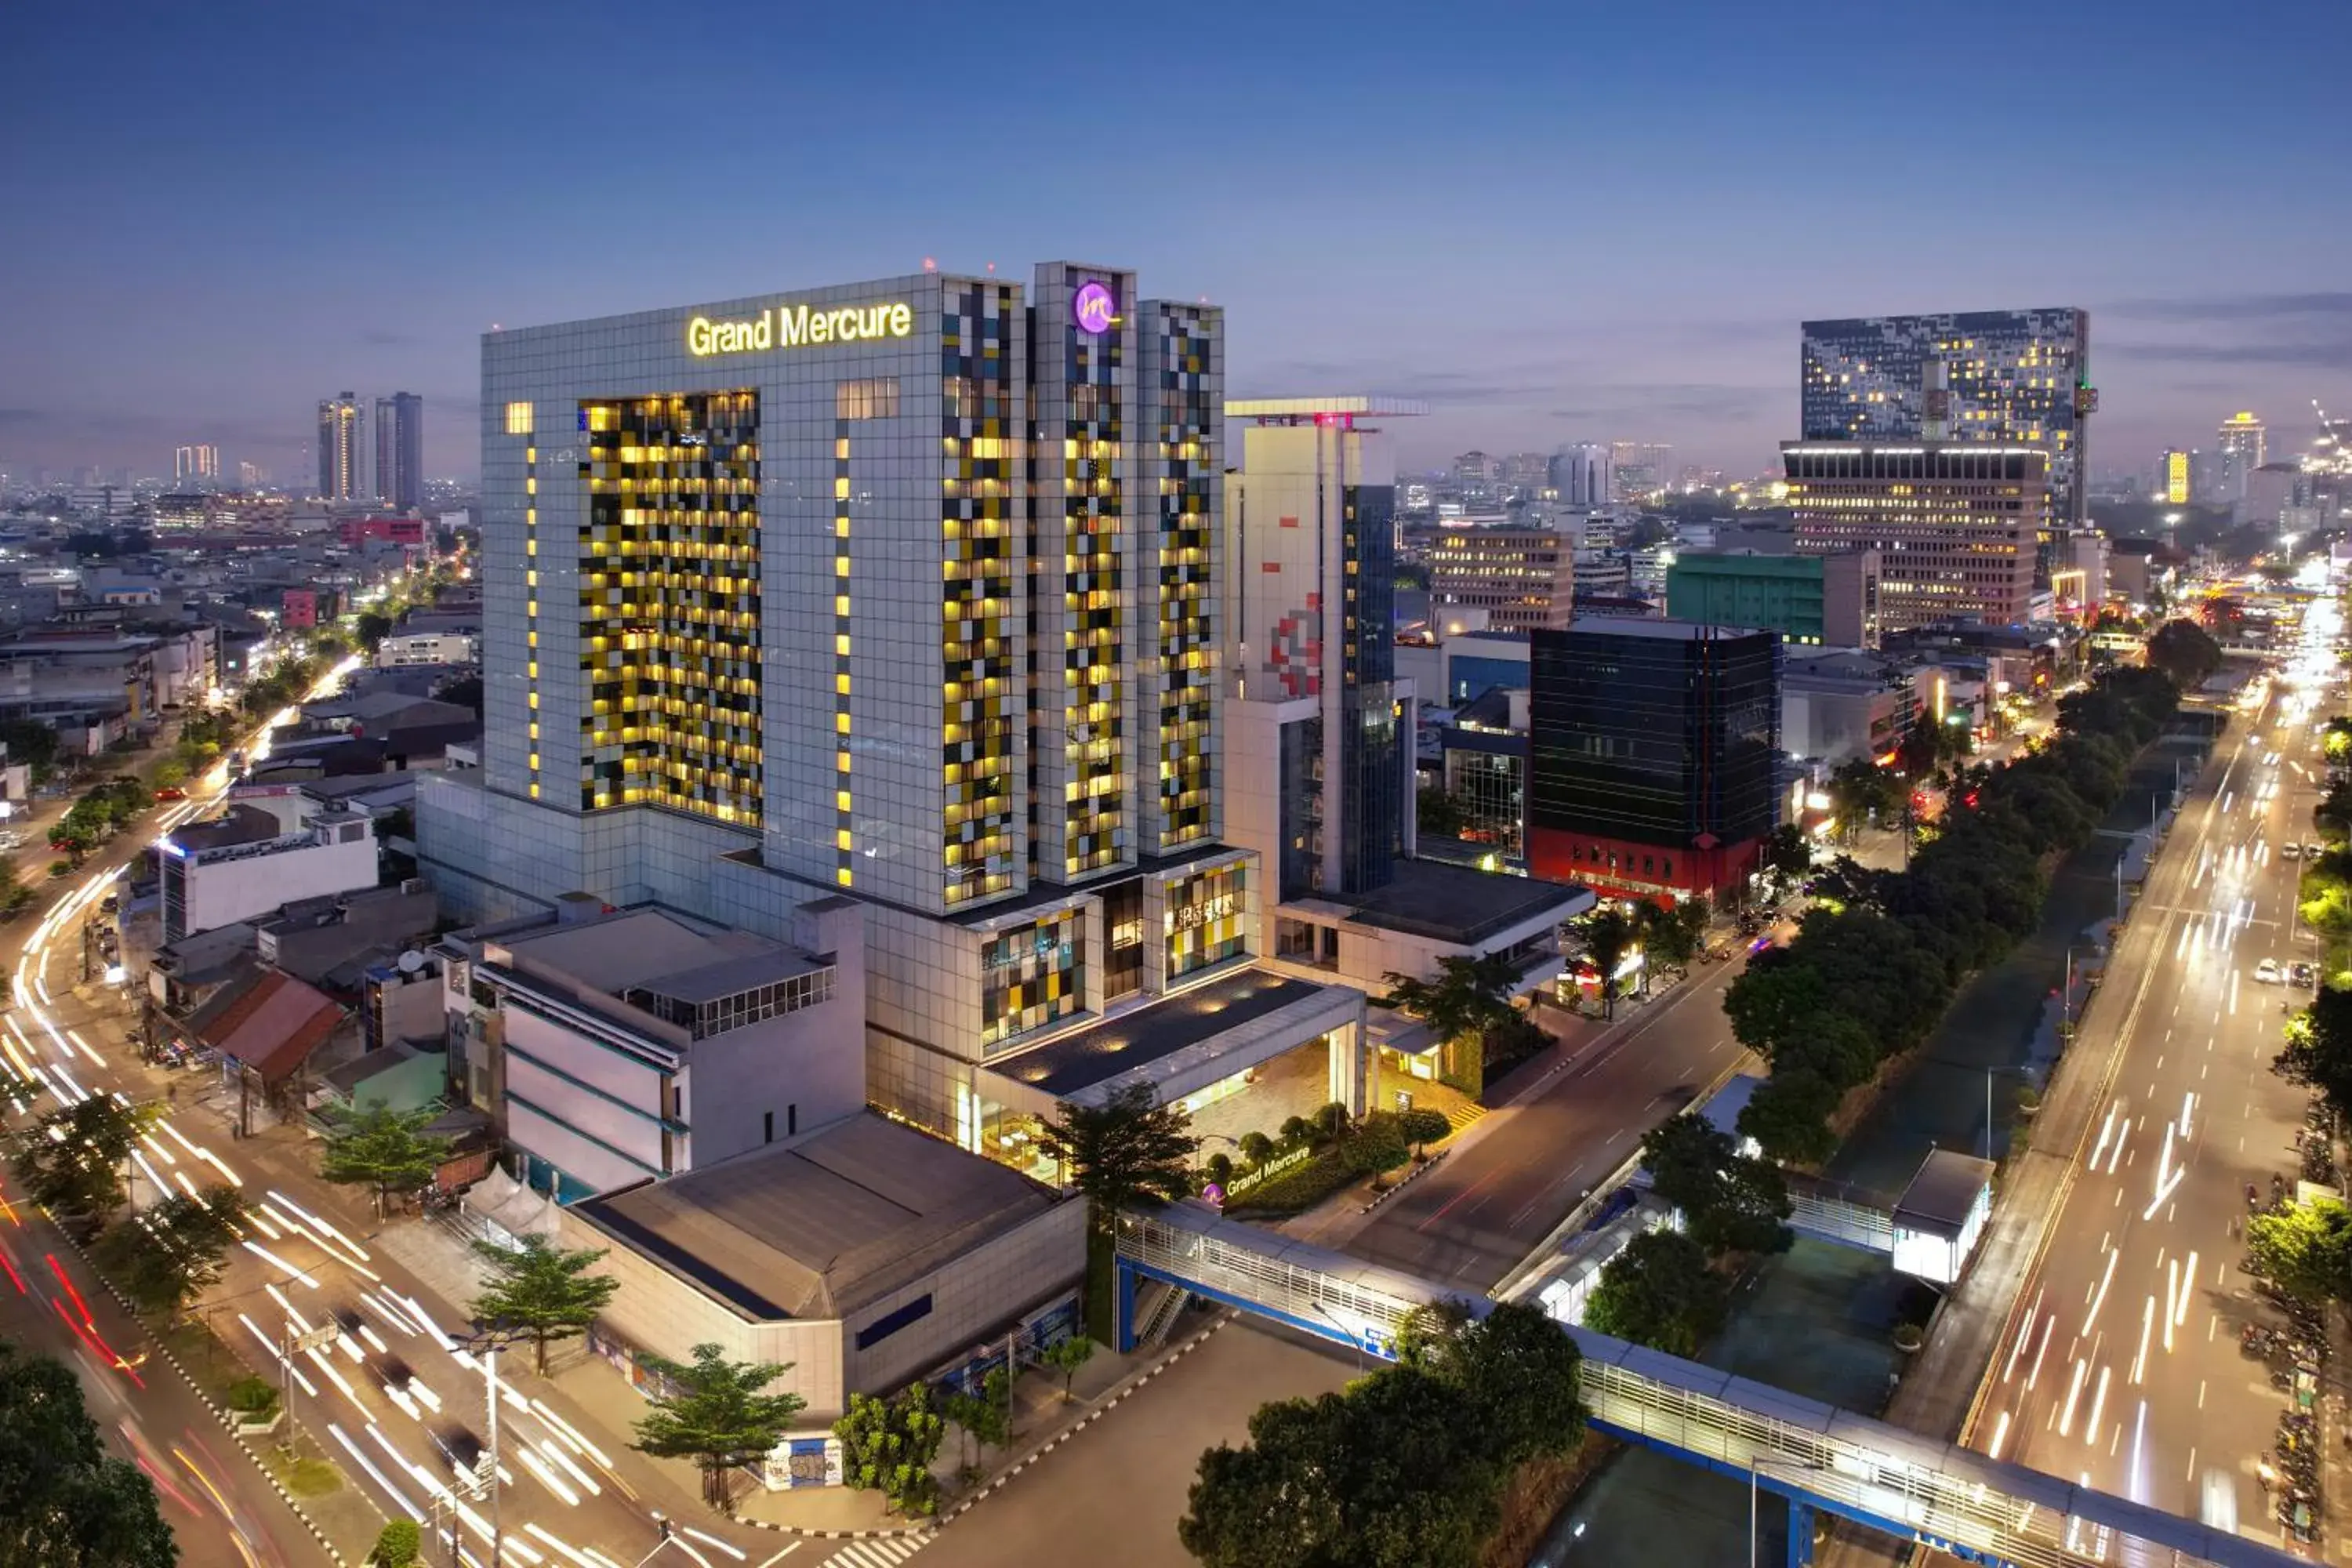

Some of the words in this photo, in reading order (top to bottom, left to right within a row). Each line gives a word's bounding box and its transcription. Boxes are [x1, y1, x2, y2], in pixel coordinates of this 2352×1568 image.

[689, 310, 771, 356] Grand
[780, 303, 911, 347] Mercure
[1227, 1168, 1261, 1196] Grand
[1264, 1145, 1310, 1177] Mercure
